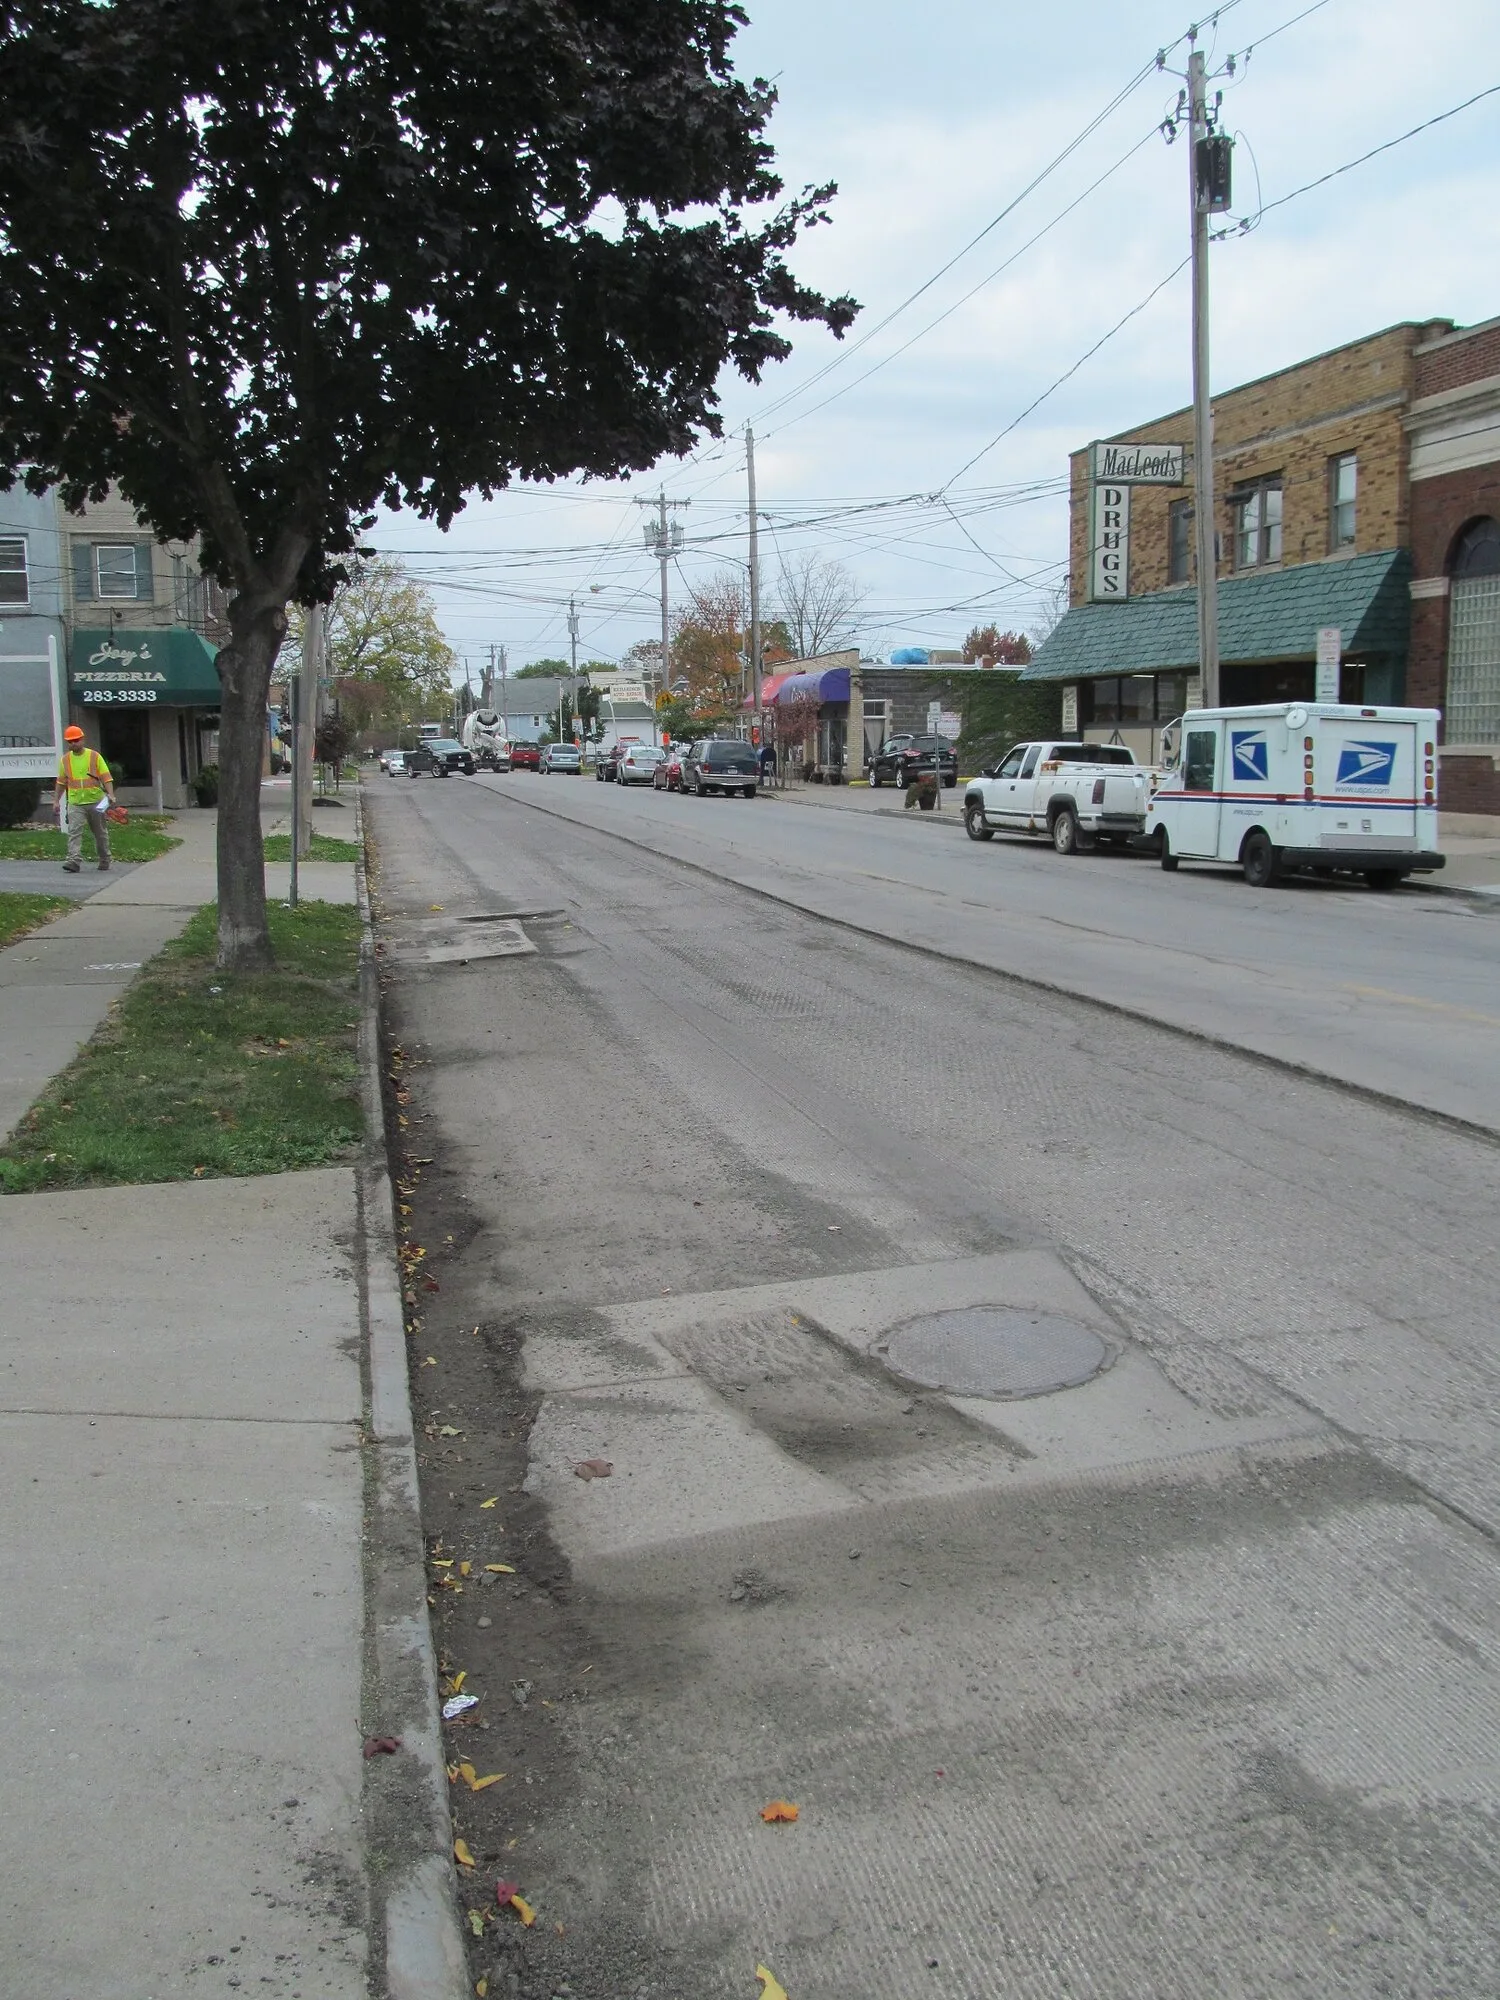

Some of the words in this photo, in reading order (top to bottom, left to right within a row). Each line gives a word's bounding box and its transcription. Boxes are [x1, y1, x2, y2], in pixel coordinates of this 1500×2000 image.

[1102, 488, 1122, 593] DRUGS
[88, 642, 152, 667] Joey's
[74, 671, 167, 682] PIZZERIA
[83, 690, 157, 702] 283-3333
[1334, 786, 1391, 795] www.usps.com
